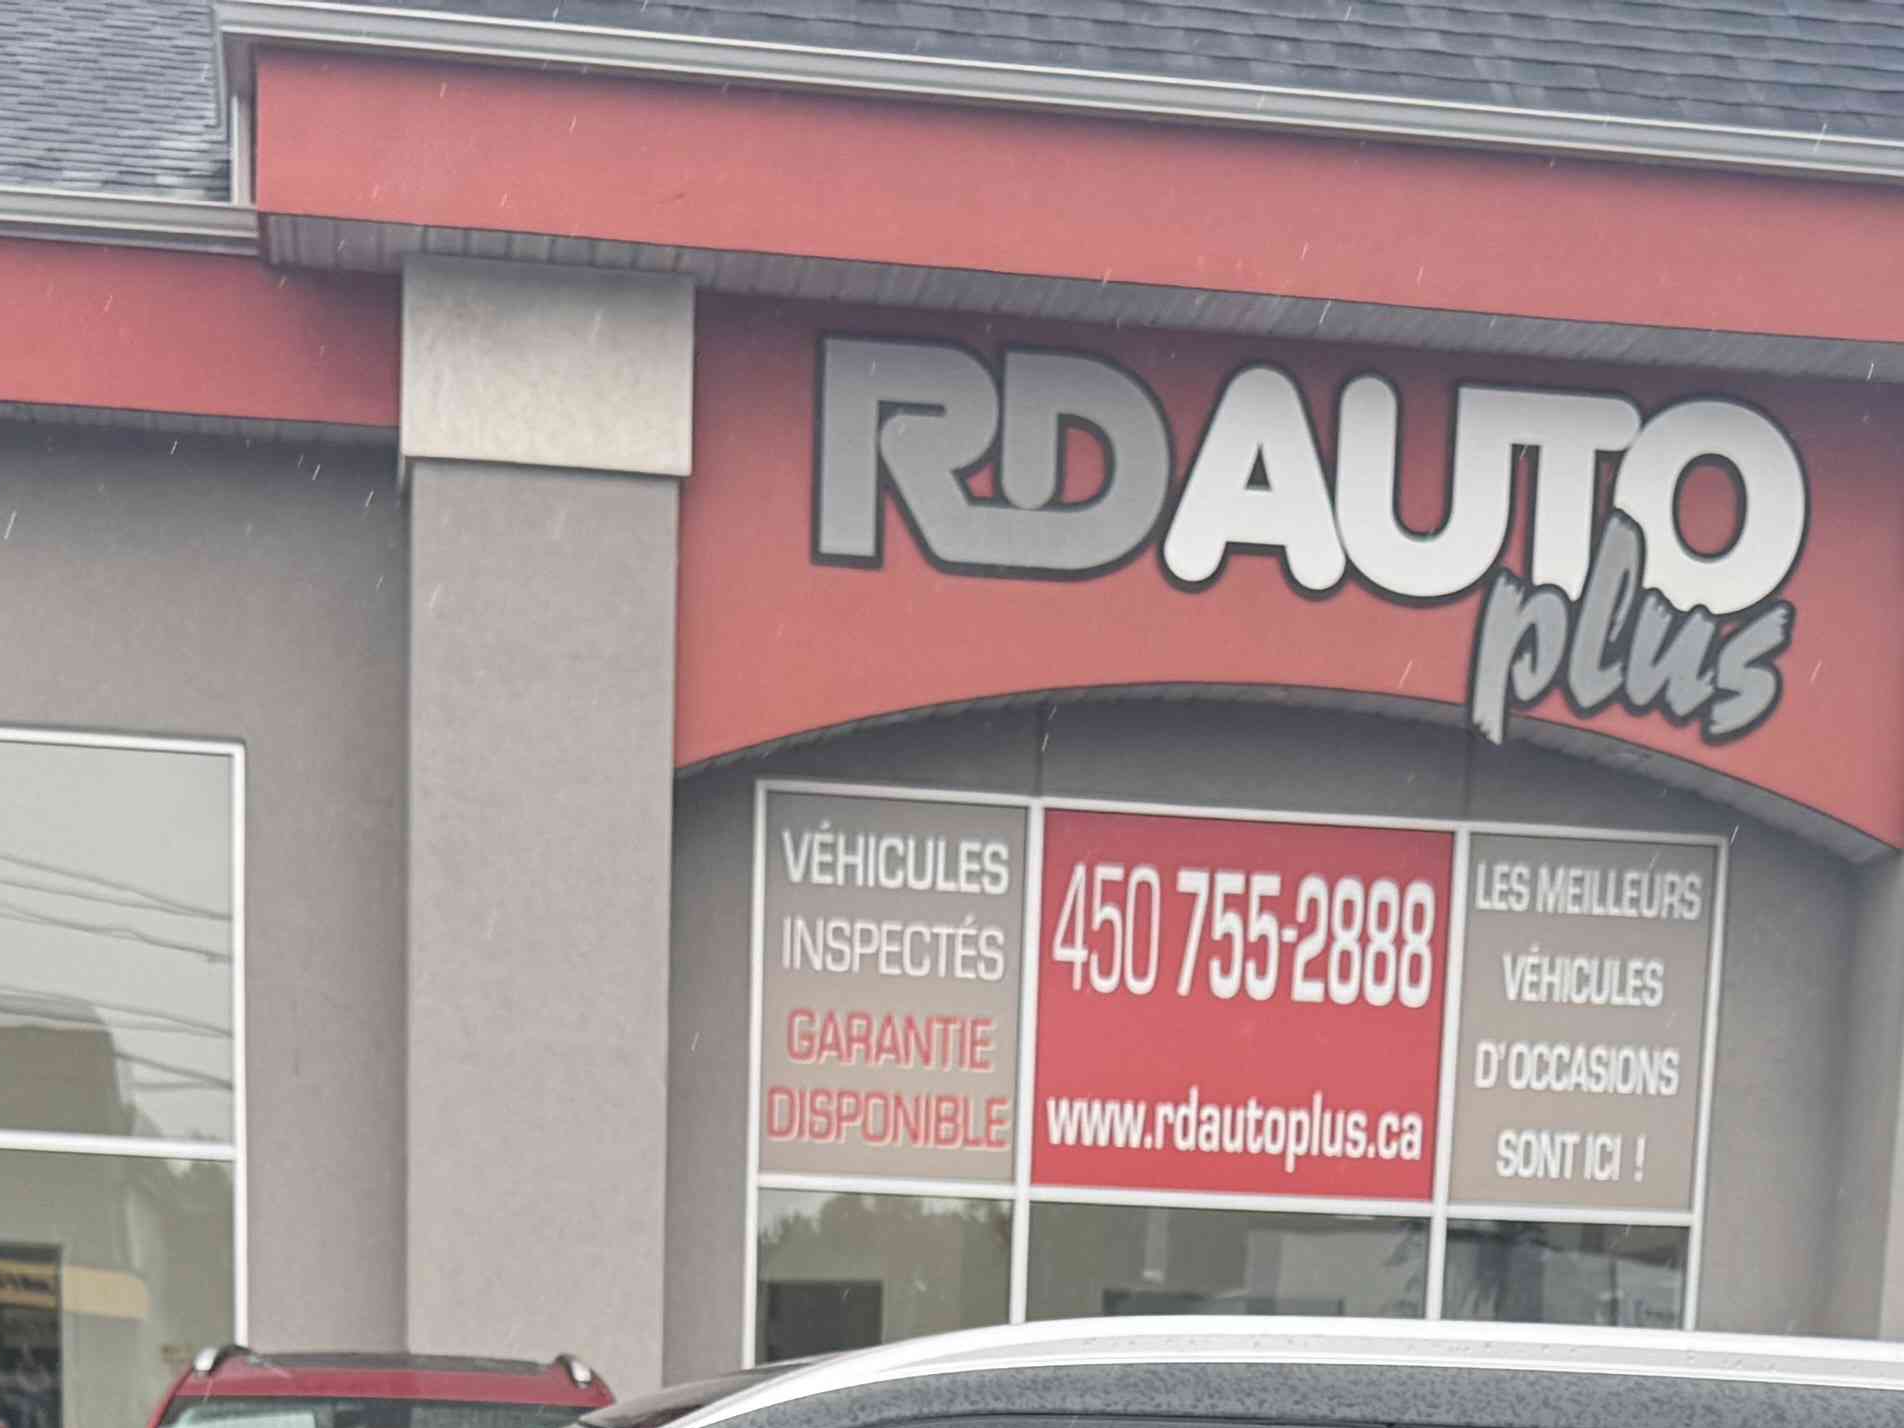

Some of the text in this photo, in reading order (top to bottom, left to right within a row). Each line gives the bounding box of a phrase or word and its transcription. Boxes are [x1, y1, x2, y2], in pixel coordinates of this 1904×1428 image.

[1467, 509, 1795, 743] plus
[782, 819, 1009, 895] VÉHICULES
[1475, 862, 1702, 920] LES MEILLEURS
[781, 913, 1005, 981] INSPECTÉS
[1052, 861, 1436, 1008] 450 755-2888
[1502, 943, 1665, 1007] VÉHICULES
[786, 1008, 995, 1073] GARANTIE
[767, 1085, 1010, 1152] DISPONIBLE
[1046, 1084, 1424, 1173] www.rdautoplus.ca
[1496, 1129, 1580, 1180] SONT
[1584, 1132, 1623, 1182] ICI
